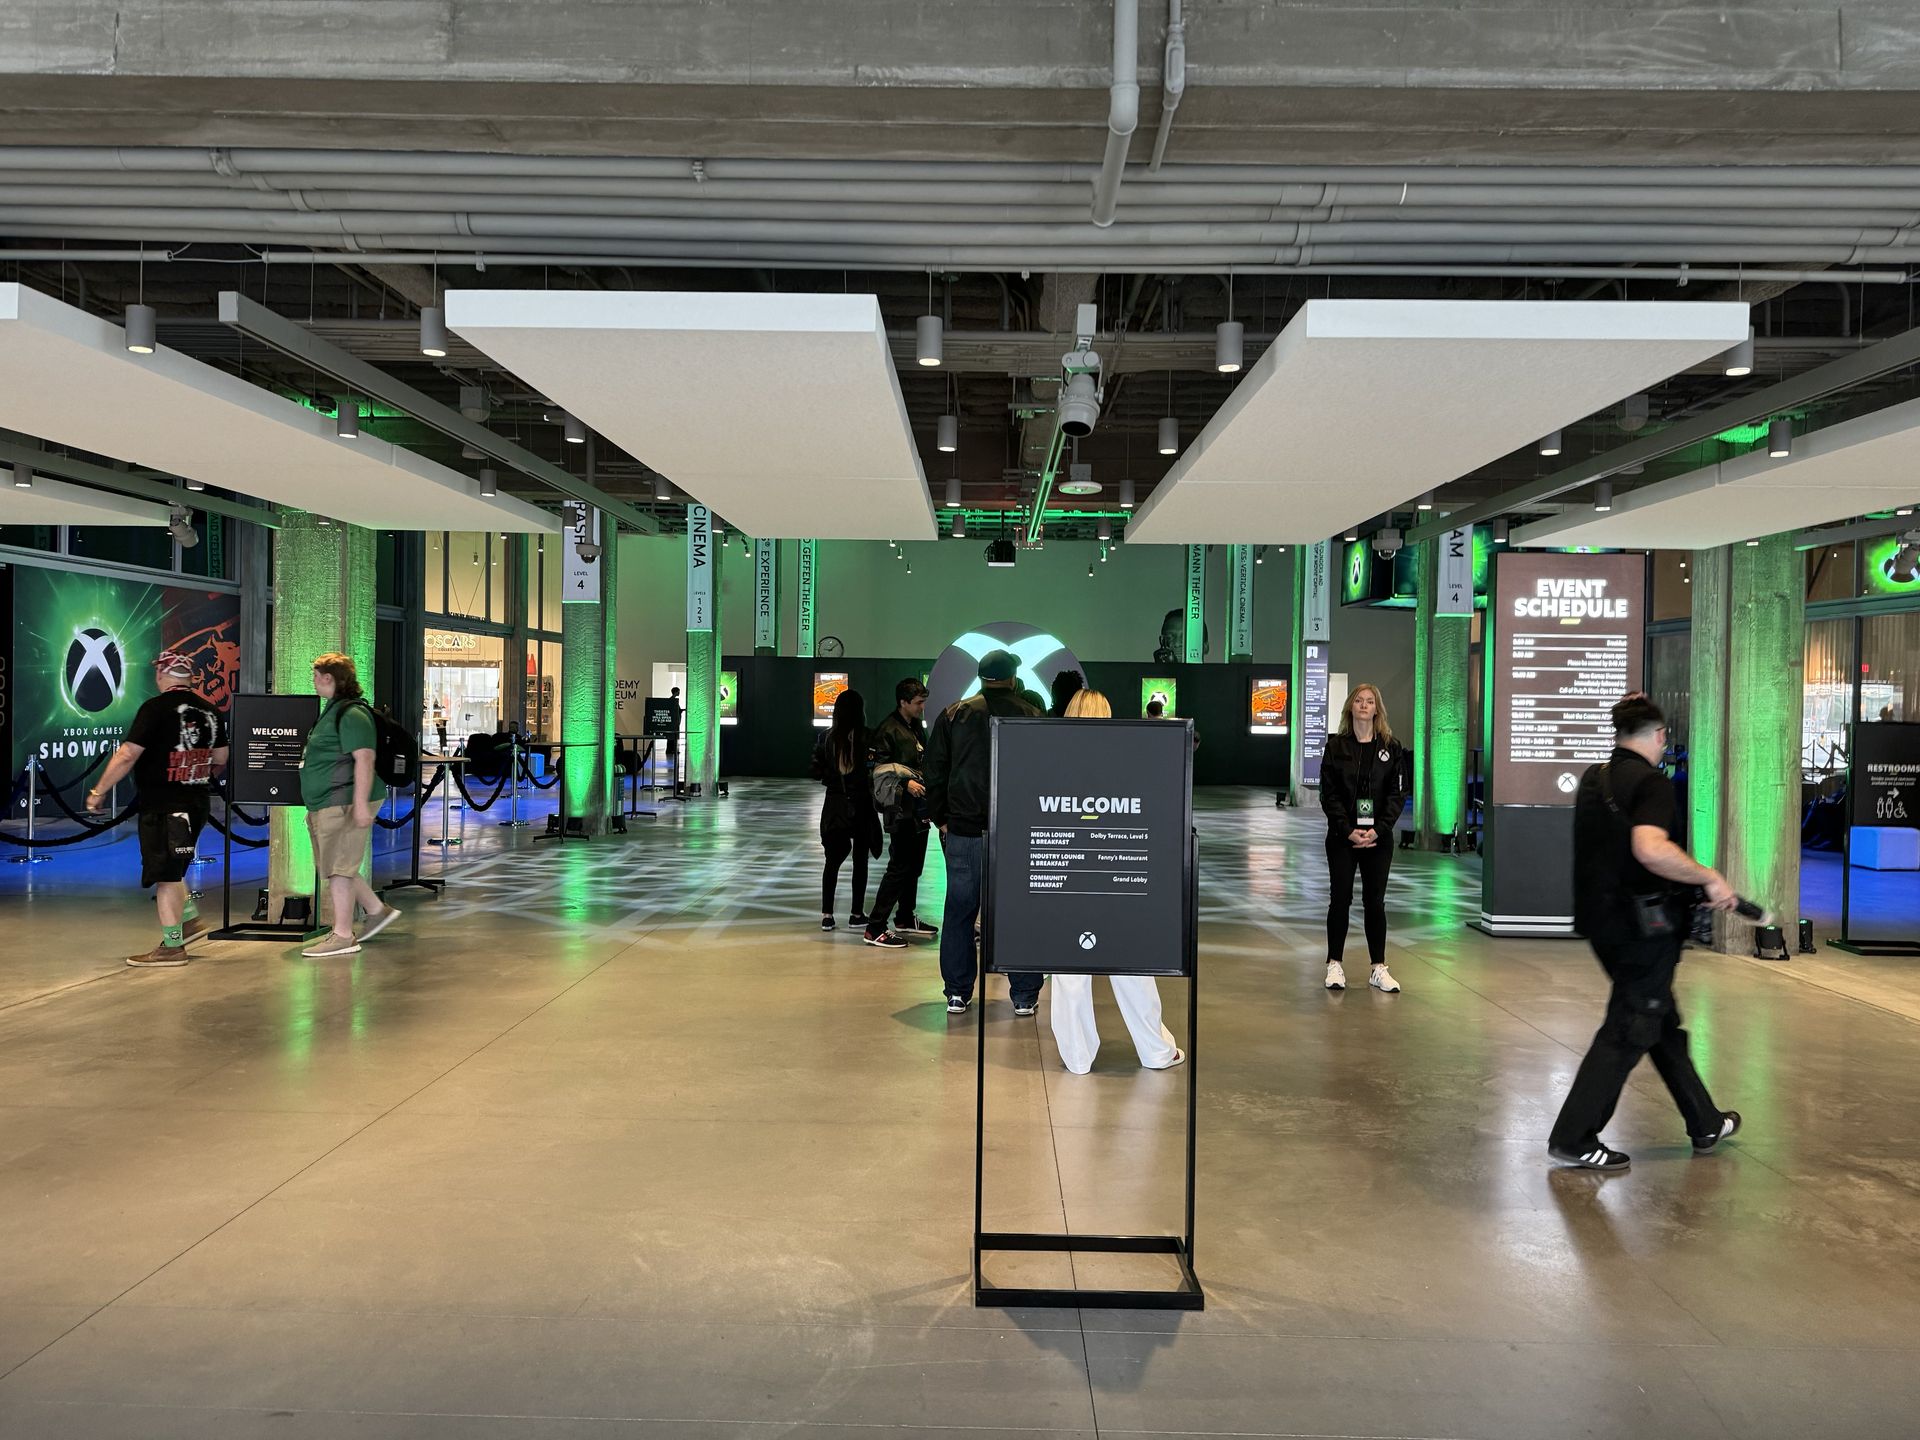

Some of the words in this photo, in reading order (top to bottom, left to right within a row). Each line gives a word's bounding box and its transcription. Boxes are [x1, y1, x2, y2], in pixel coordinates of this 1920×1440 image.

[693, 505, 706, 568] CINEMA
[1450, 529, 1464, 557] AM
[802, 546, 811, 585] GEFFEN
[1192, 544, 1200, 574] MANN
[577, 580, 585, 589] 4
[761, 550, 769, 617] EXPERIENCE
[1536, 578, 1607, 598] EVENT
[1191, 576, 1200, 620] THEATER
[1452, 592, 1459, 604] 4
[802, 588, 811, 631] THEATER
[1514, 598, 1628, 618] SCHEDULE
[697, 616, 702, 624] 3
[1314, 624, 1319, 632] 3
[424, 634, 476, 648] OSCARS
[63, 727, 88, 737] XBOX
[93, 726, 123, 735] GAMES
[252, 727, 298, 736] WELCOME
[1867, 763, 1920, 773] RESTROOMS
[1038, 796, 1141, 814] WELCOME
[1090, 832, 1107, 840] Dolby
[1107, 832, 1129, 840] Terrace,
[1097, 854, 1118, 862] Fanny's
[1130, 876, 1148, 884] Lobby
